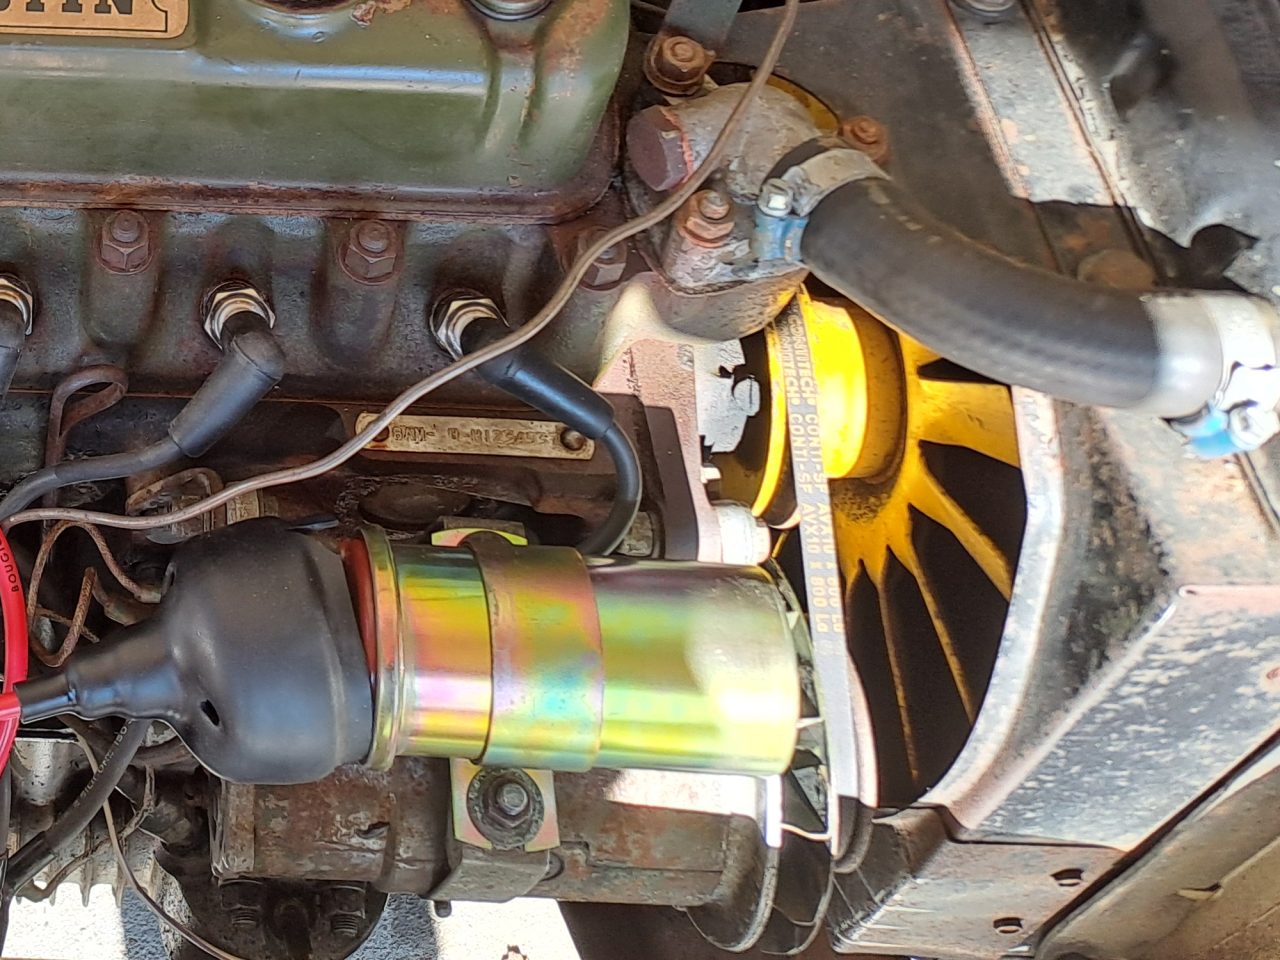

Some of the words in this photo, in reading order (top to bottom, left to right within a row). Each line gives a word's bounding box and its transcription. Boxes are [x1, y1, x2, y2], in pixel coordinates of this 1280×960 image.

[790, 413, 813, 494] CONTI-SF
[801, 502, 820, 554] AVX10
[810, 575, 827, 608] 800
